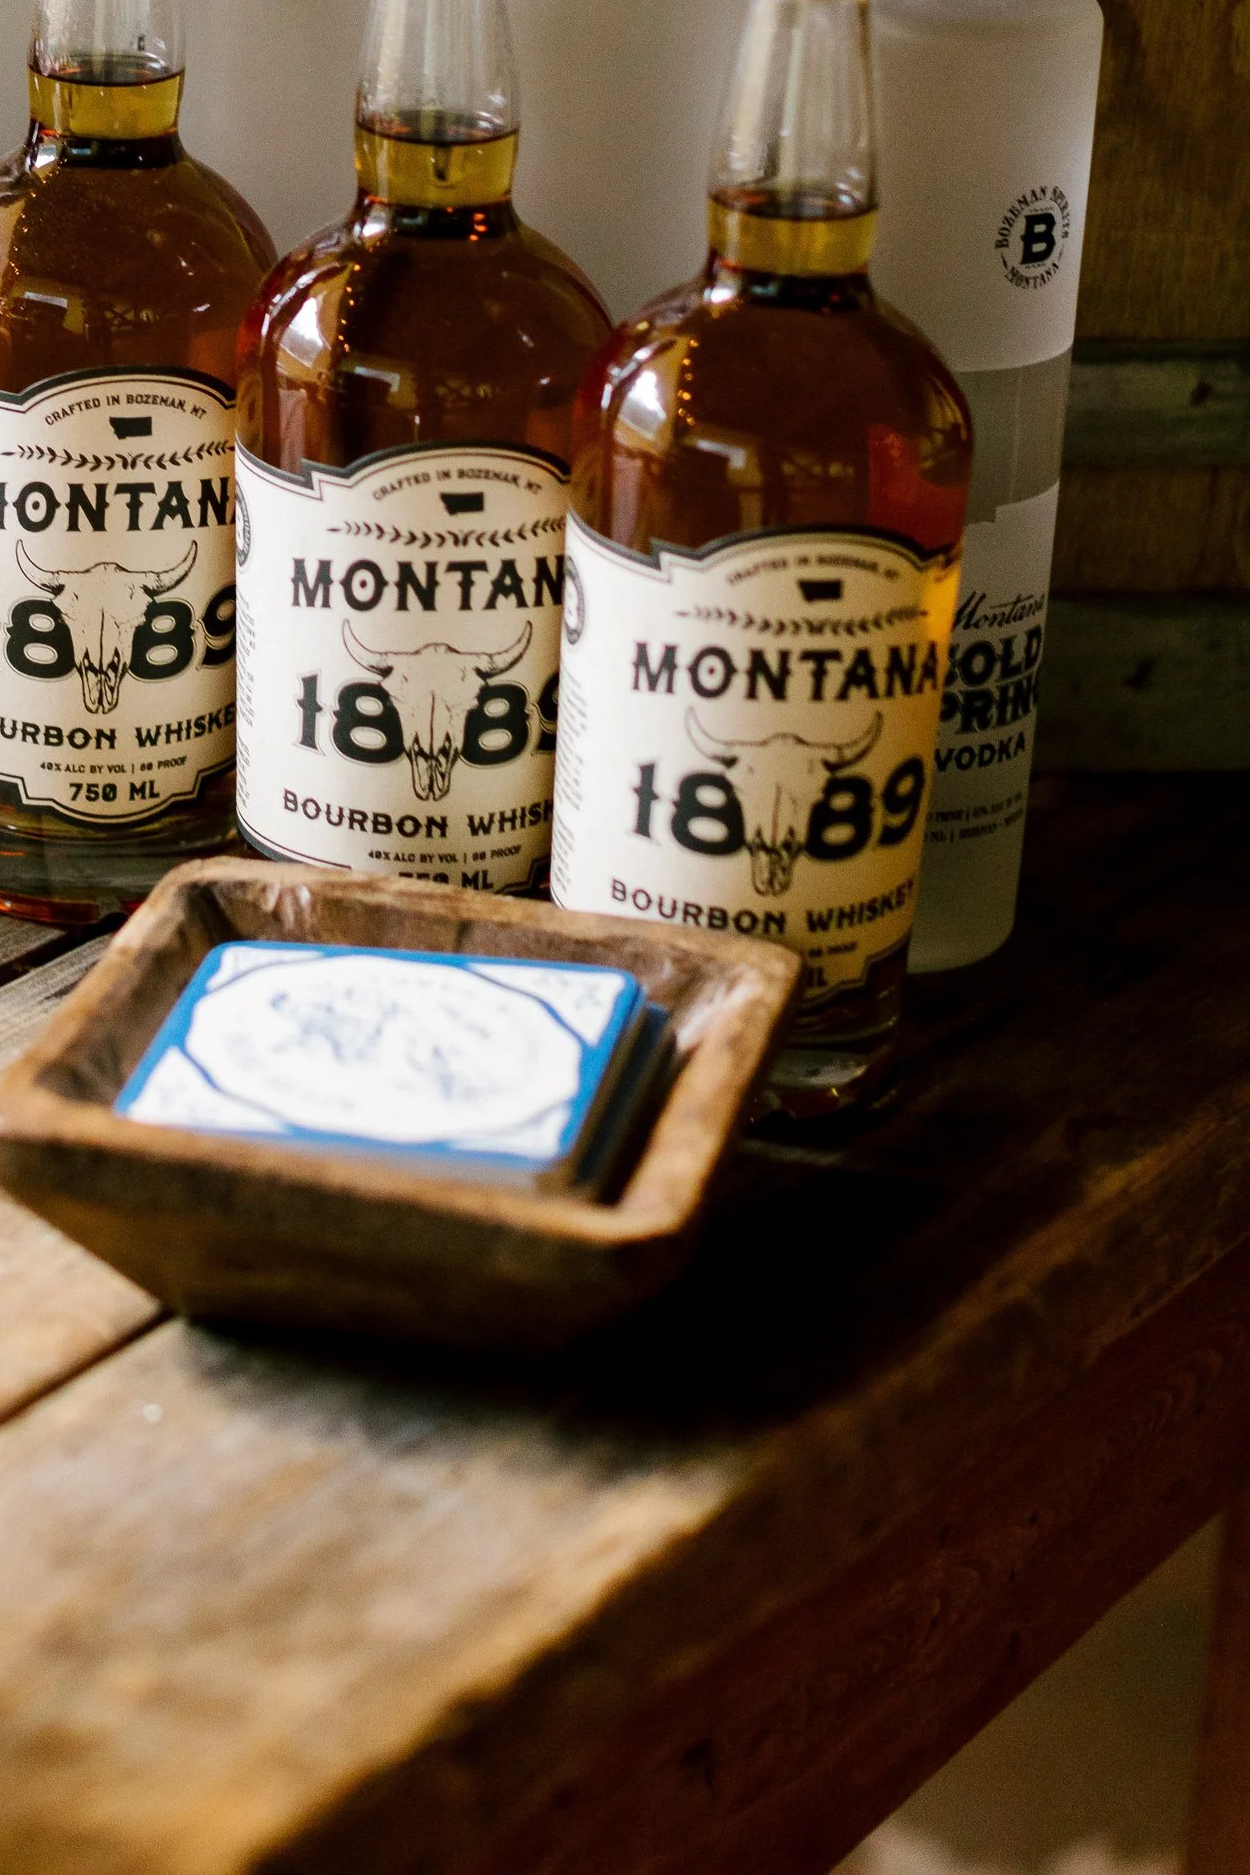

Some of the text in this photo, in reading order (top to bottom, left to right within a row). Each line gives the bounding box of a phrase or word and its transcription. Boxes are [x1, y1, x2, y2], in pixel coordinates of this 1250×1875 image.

[1019, 212, 1057, 265] B
[45, 398, 101, 426] CRAFTED
[106, 395, 120, 406] IN
[190, 406, 207, 421] MT
[372, 472, 431, 501] CRAFTED
[436, 469, 451, 482] IN
[631, 640, 938, 702] MONTANA
[64, 764, 86, 774] ALC
[90, 764, 104, 774] BY
[107, 764, 127, 774] VOL
[157, 755, 188, 770] PROOF
[934, 731, 1026, 772] VODKA
[69, 779, 161, 802] 750 ML
[630, 755, 926, 862] 1889
[283, 787, 448, 839] BOURBON
[393, 852, 416, 863] ALC
[461, 869, 495, 891] ML
[611, 878, 787, 934] BOURBON
